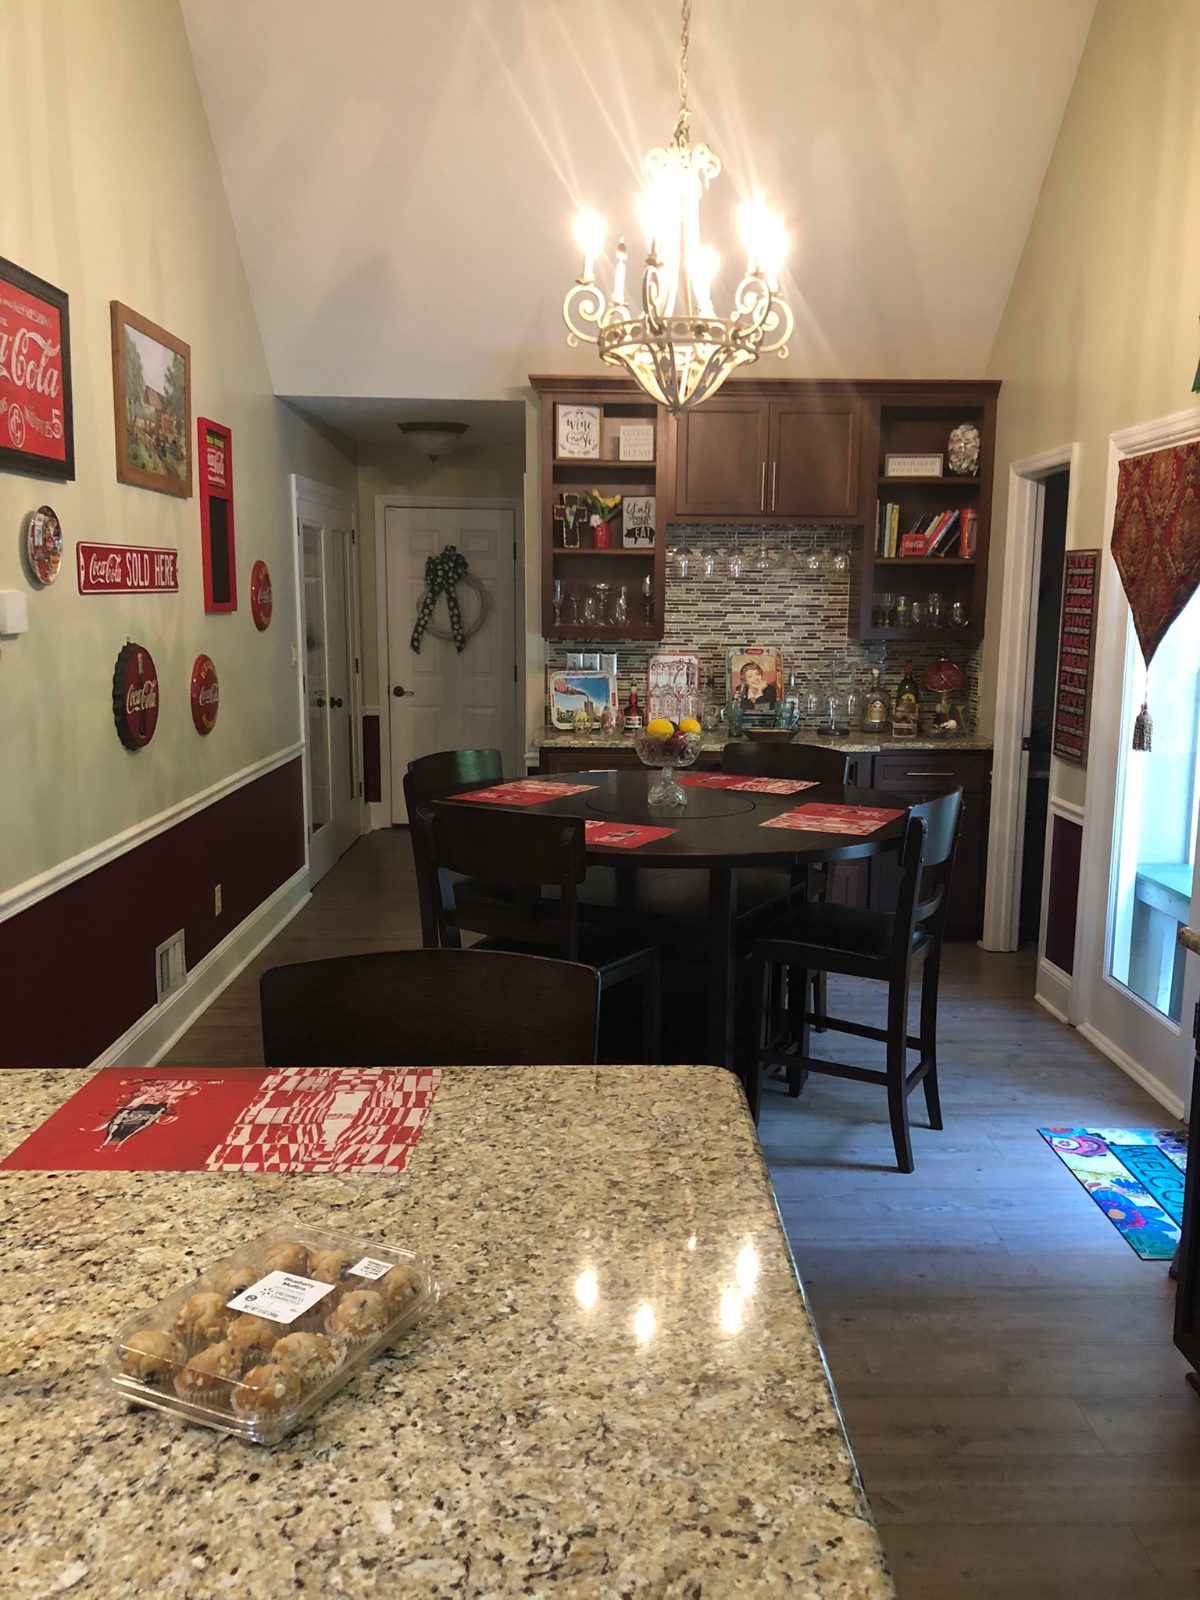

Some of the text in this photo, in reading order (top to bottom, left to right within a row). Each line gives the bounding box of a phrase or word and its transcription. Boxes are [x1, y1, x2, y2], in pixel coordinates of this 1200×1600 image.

[635, 527, 650, 538] EAT
[1068, 555, 1095, 568] LIVE
[126, 552, 150, 586] SOLD
[154, 554, 175, 586] HERE
[1066, 575, 1093, 588] LOVE
[1065, 595, 1092, 607] LAUGH
[1064, 614, 1090, 628] SING
[1062, 634, 1089, 648] DANCE
[1060, 671, 1087, 688] PLAY
[1060, 692, 1085, 709] GIVE
[282, 1282, 306, 1291] Muffins
[283, 1277, 315, 1288] Blueberry
